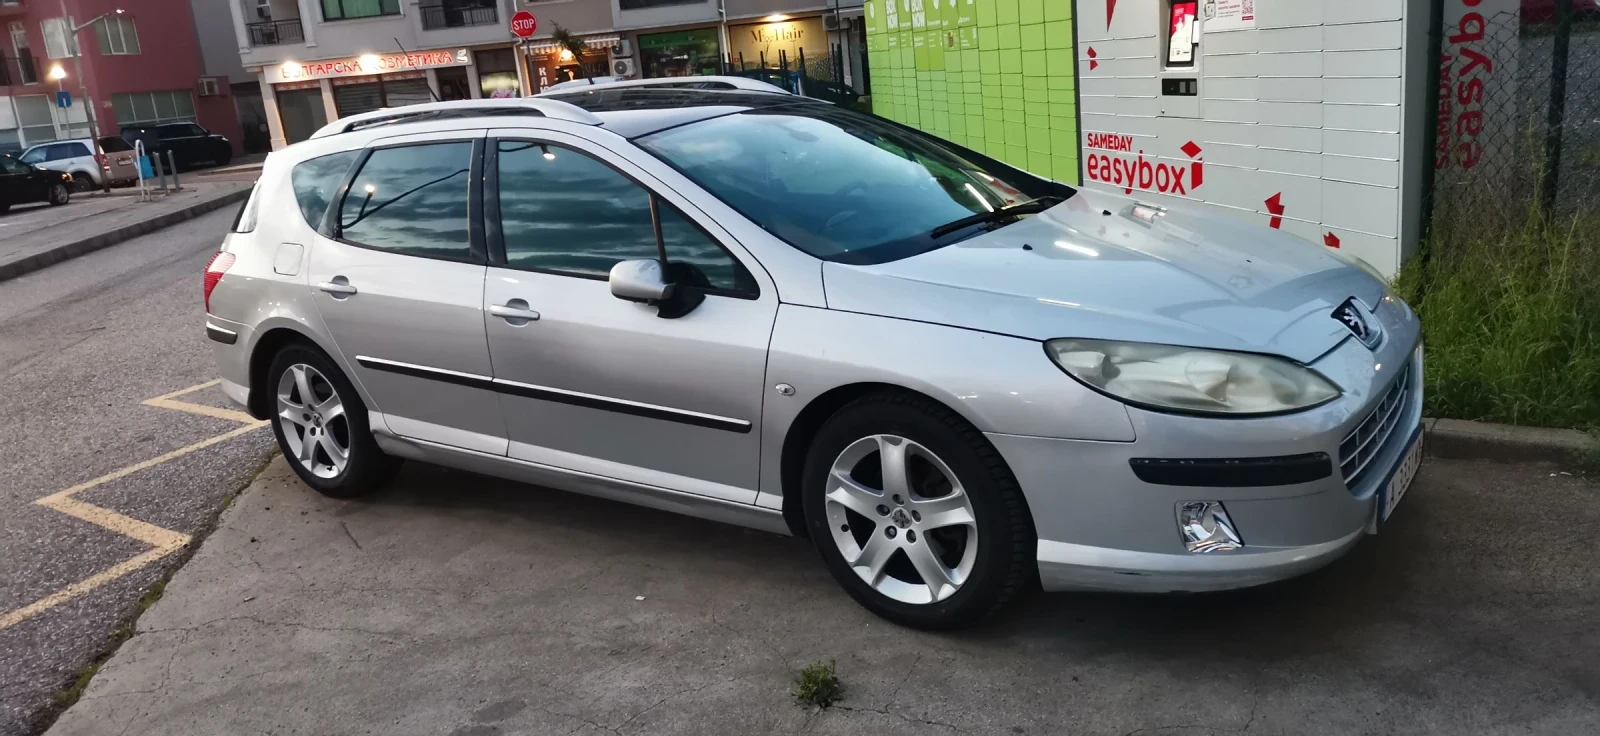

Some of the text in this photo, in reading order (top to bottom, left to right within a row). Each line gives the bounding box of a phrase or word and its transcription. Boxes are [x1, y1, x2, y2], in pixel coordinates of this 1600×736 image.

[513, 18, 535, 31] STOP
[368, 51, 453, 72] ОЗМЕТИКА
[1448, 0, 1493, 169] easyb
[1434, 53, 1453, 170] SAMEDAY
[1087, 132, 1133, 152] SAMEDAY
[1087, 149, 1187, 196] easybox
